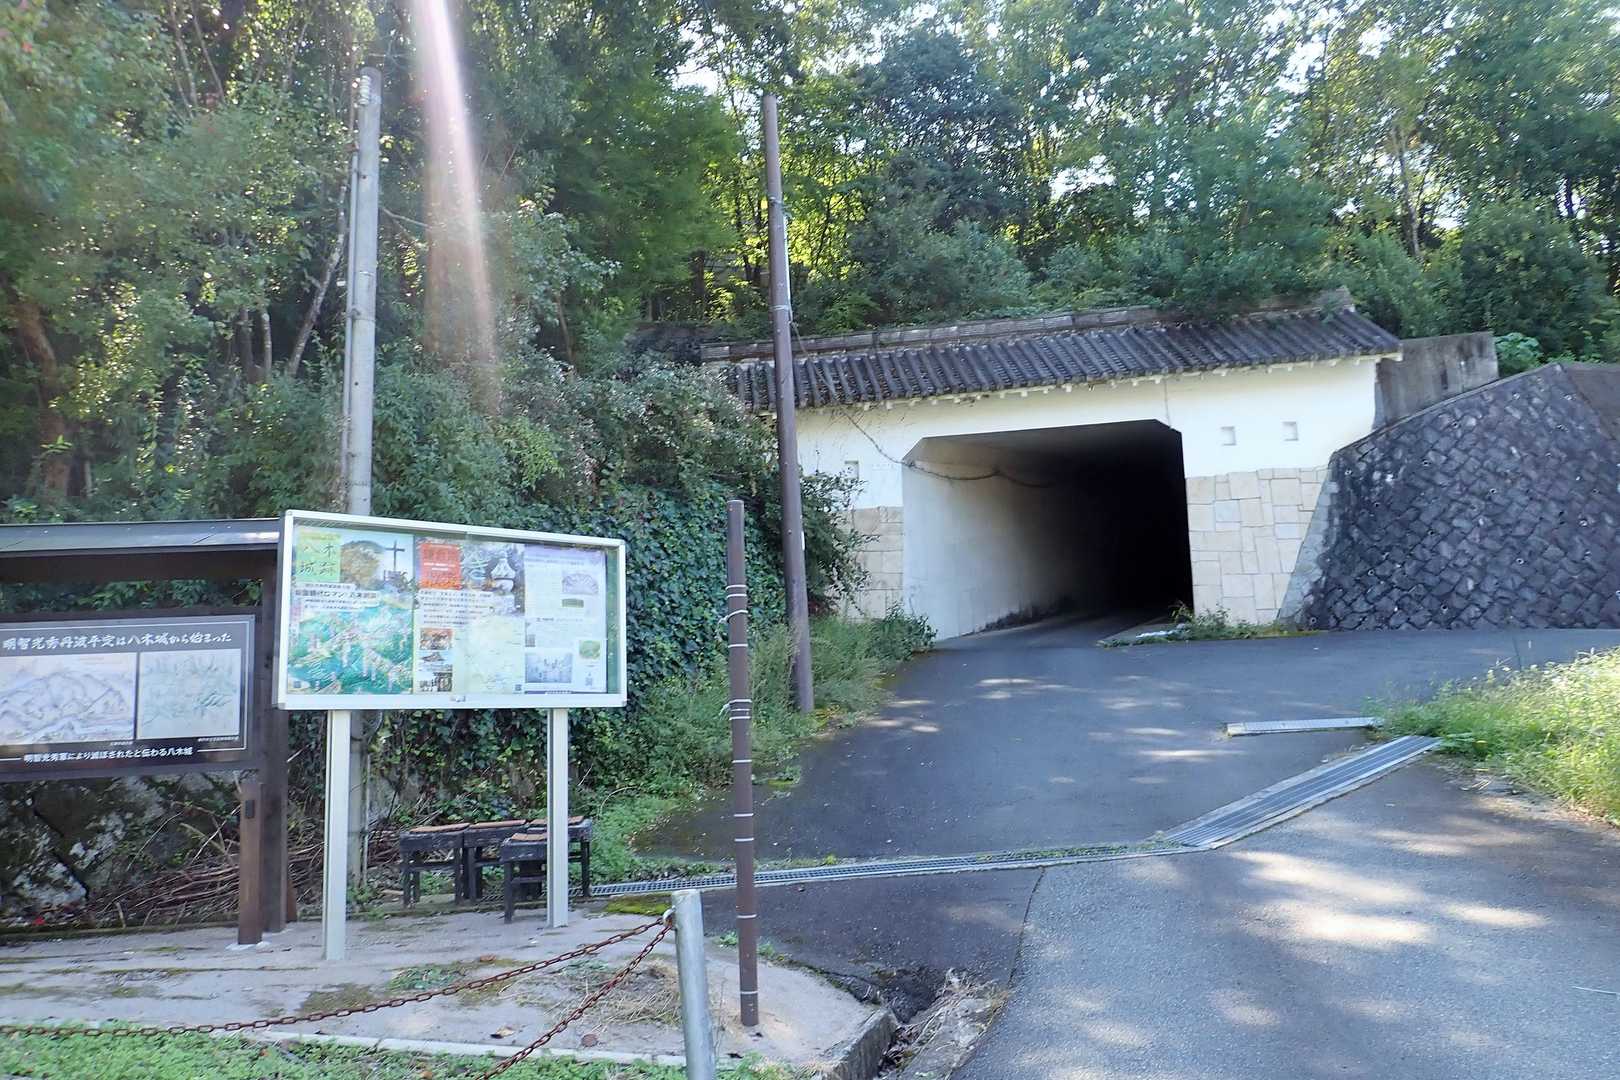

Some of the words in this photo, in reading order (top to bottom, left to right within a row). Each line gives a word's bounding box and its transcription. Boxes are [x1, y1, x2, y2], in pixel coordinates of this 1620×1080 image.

[3, 631, 232, 650] 明智光秀丹波平定は八木城から始まった
